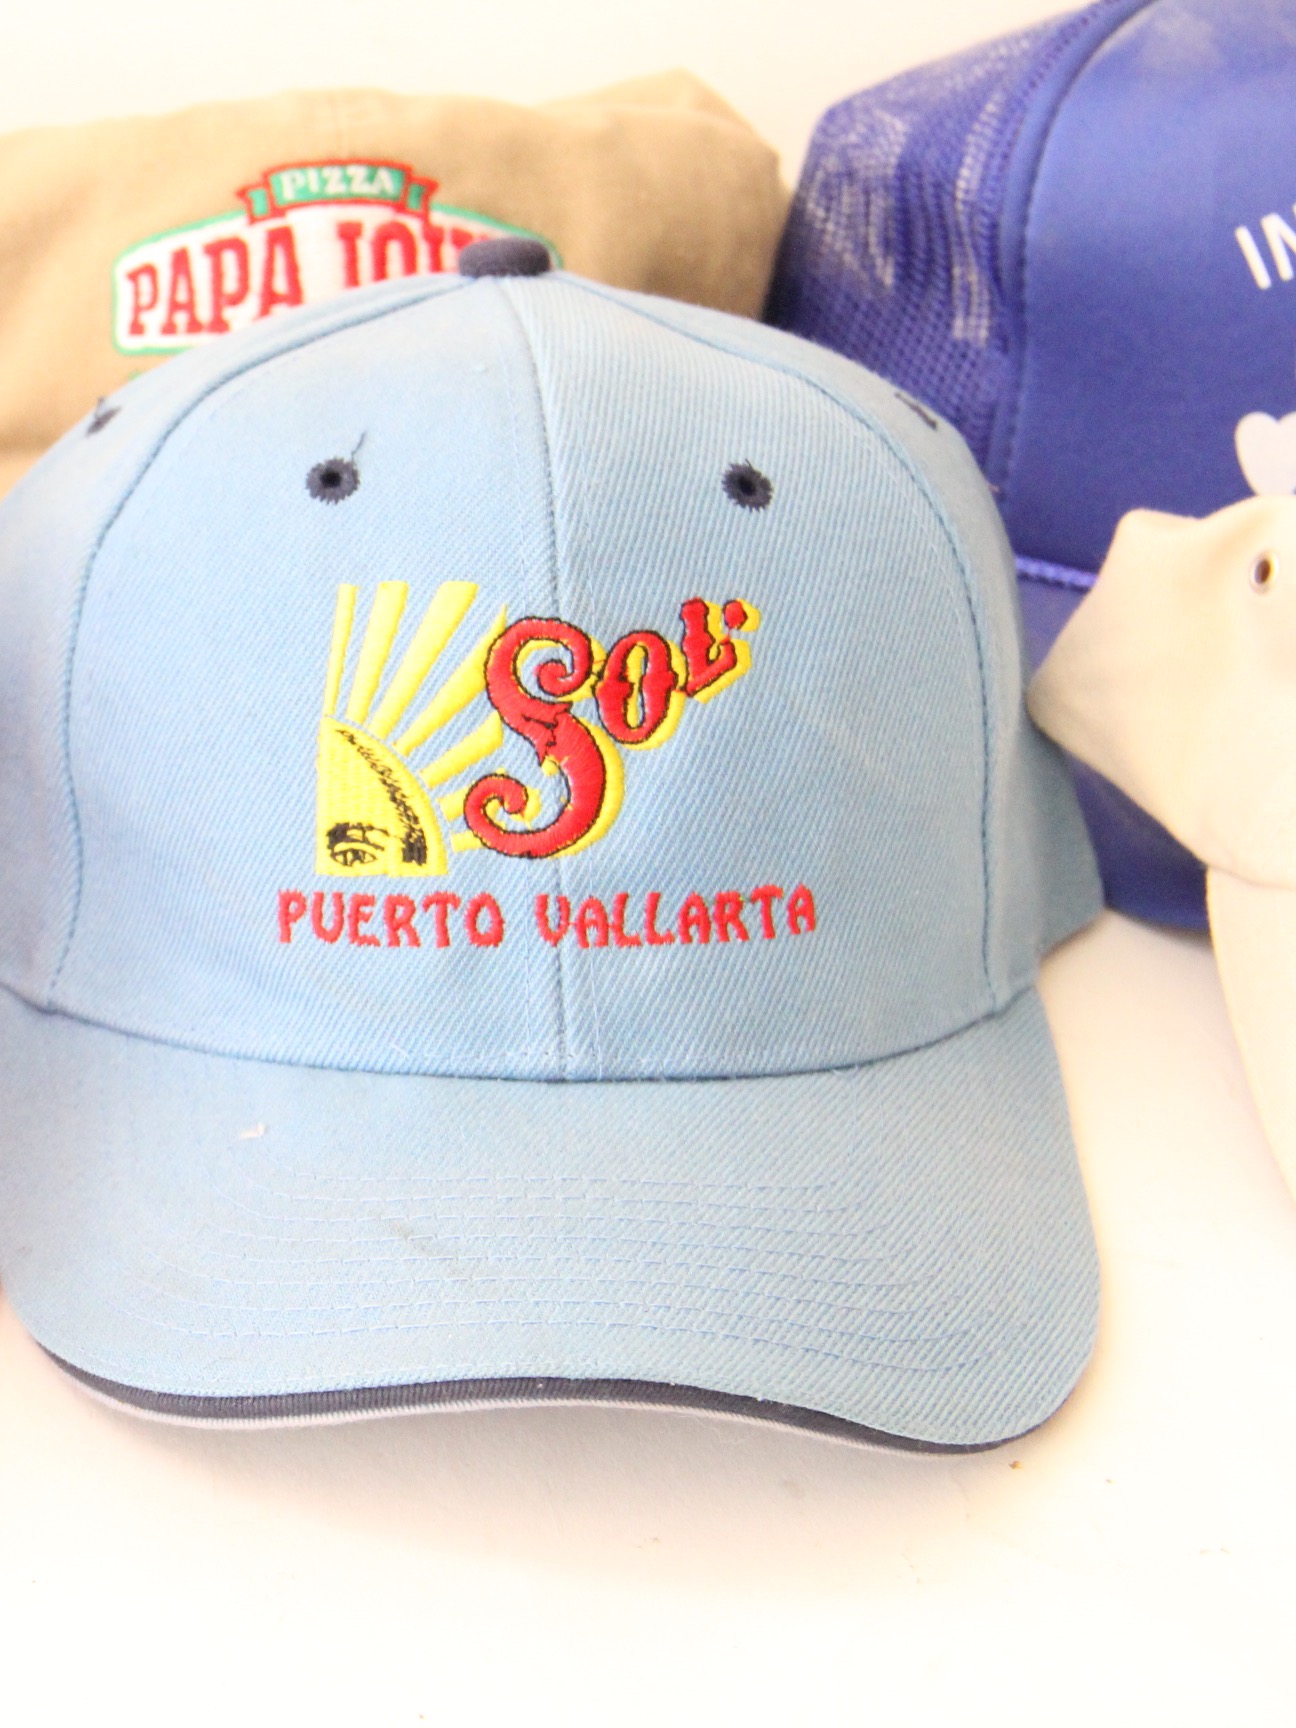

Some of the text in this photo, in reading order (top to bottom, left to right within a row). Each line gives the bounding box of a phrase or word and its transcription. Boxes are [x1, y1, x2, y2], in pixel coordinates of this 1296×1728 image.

[279, 163, 396, 200] PIZZA
[126, 226, 304, 337] PAPA
[277, 883, 818, 950] PUERTO VALLARTA
